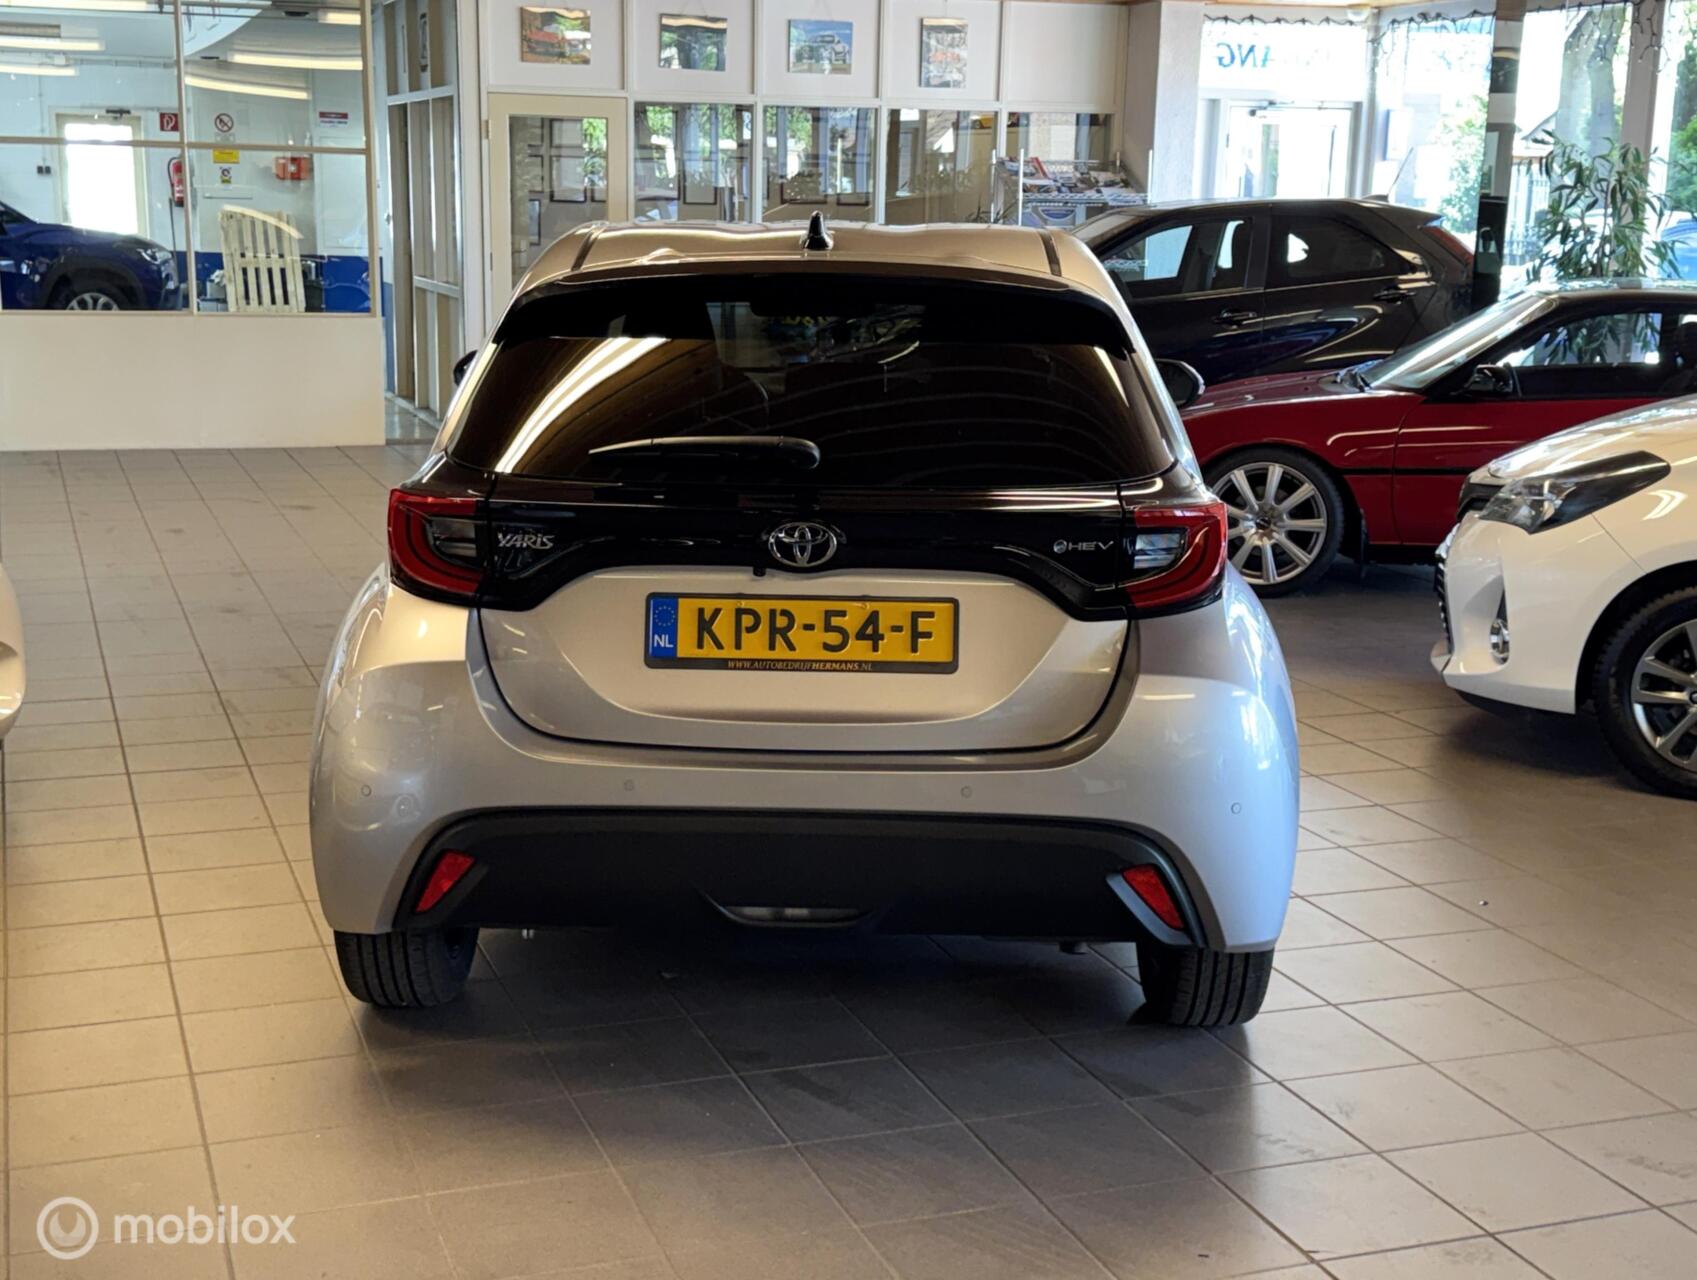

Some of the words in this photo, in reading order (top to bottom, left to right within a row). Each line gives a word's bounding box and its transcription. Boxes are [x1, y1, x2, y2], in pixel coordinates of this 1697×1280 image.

[497, 532, 555, 549] YARIS
[1068, 540, 1114, 551] HEV
[696, 607, 935, 653] KPR-54-F
[654, 634, 673, 648] NL
